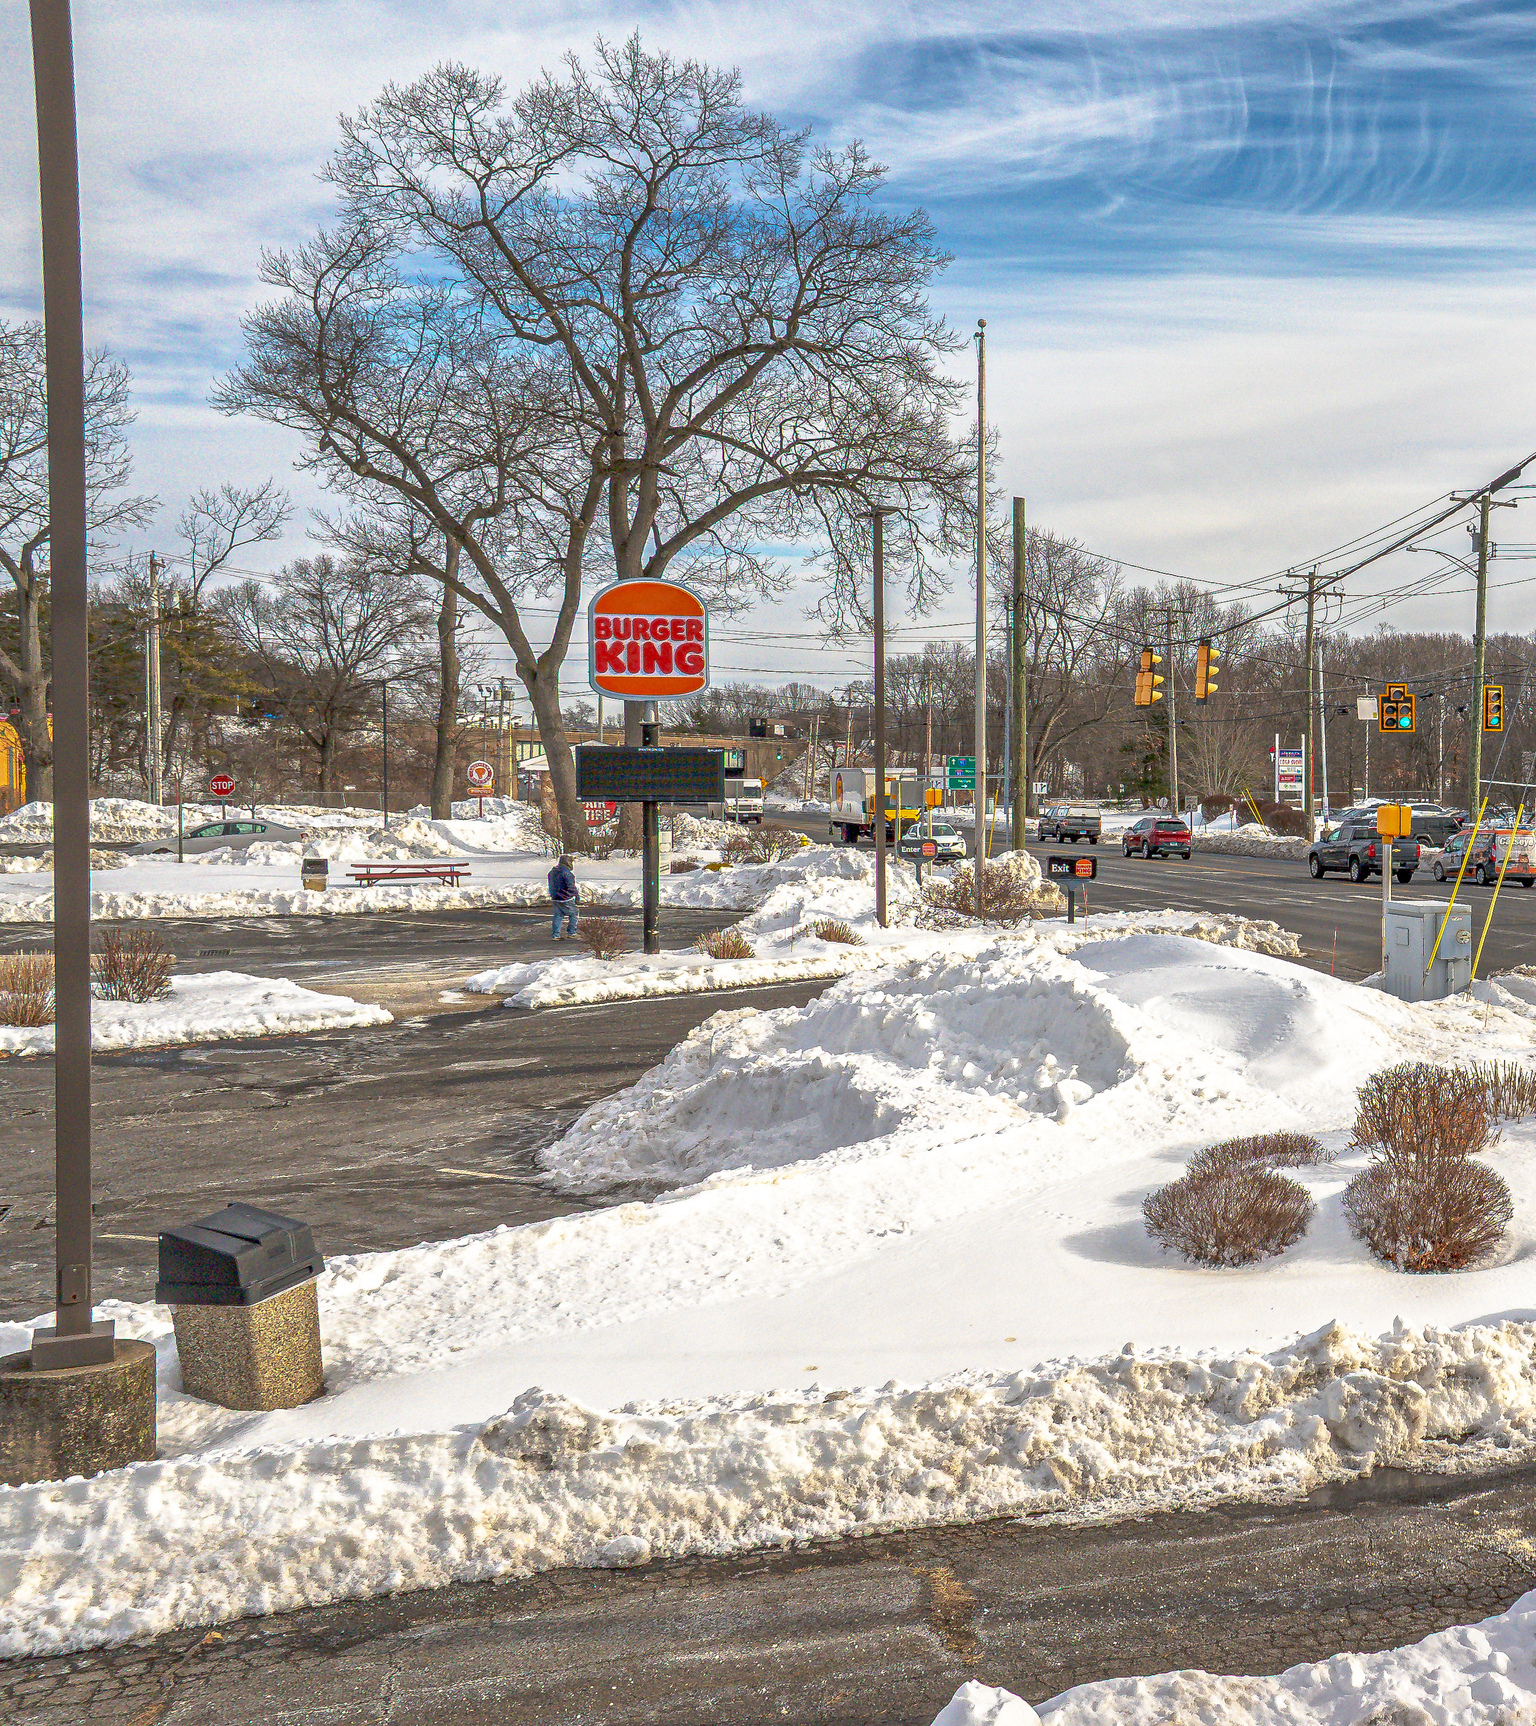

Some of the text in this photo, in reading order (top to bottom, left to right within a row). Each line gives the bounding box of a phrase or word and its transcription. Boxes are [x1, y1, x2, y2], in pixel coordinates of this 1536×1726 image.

[595, 617, 704, 641] BURGER
[595, 640, 705, 675] KING
[212, 781, 233, 790] STOP
[584, 809, 611, 821] TIRE
[1051, 863, 1070, 873] Exit
